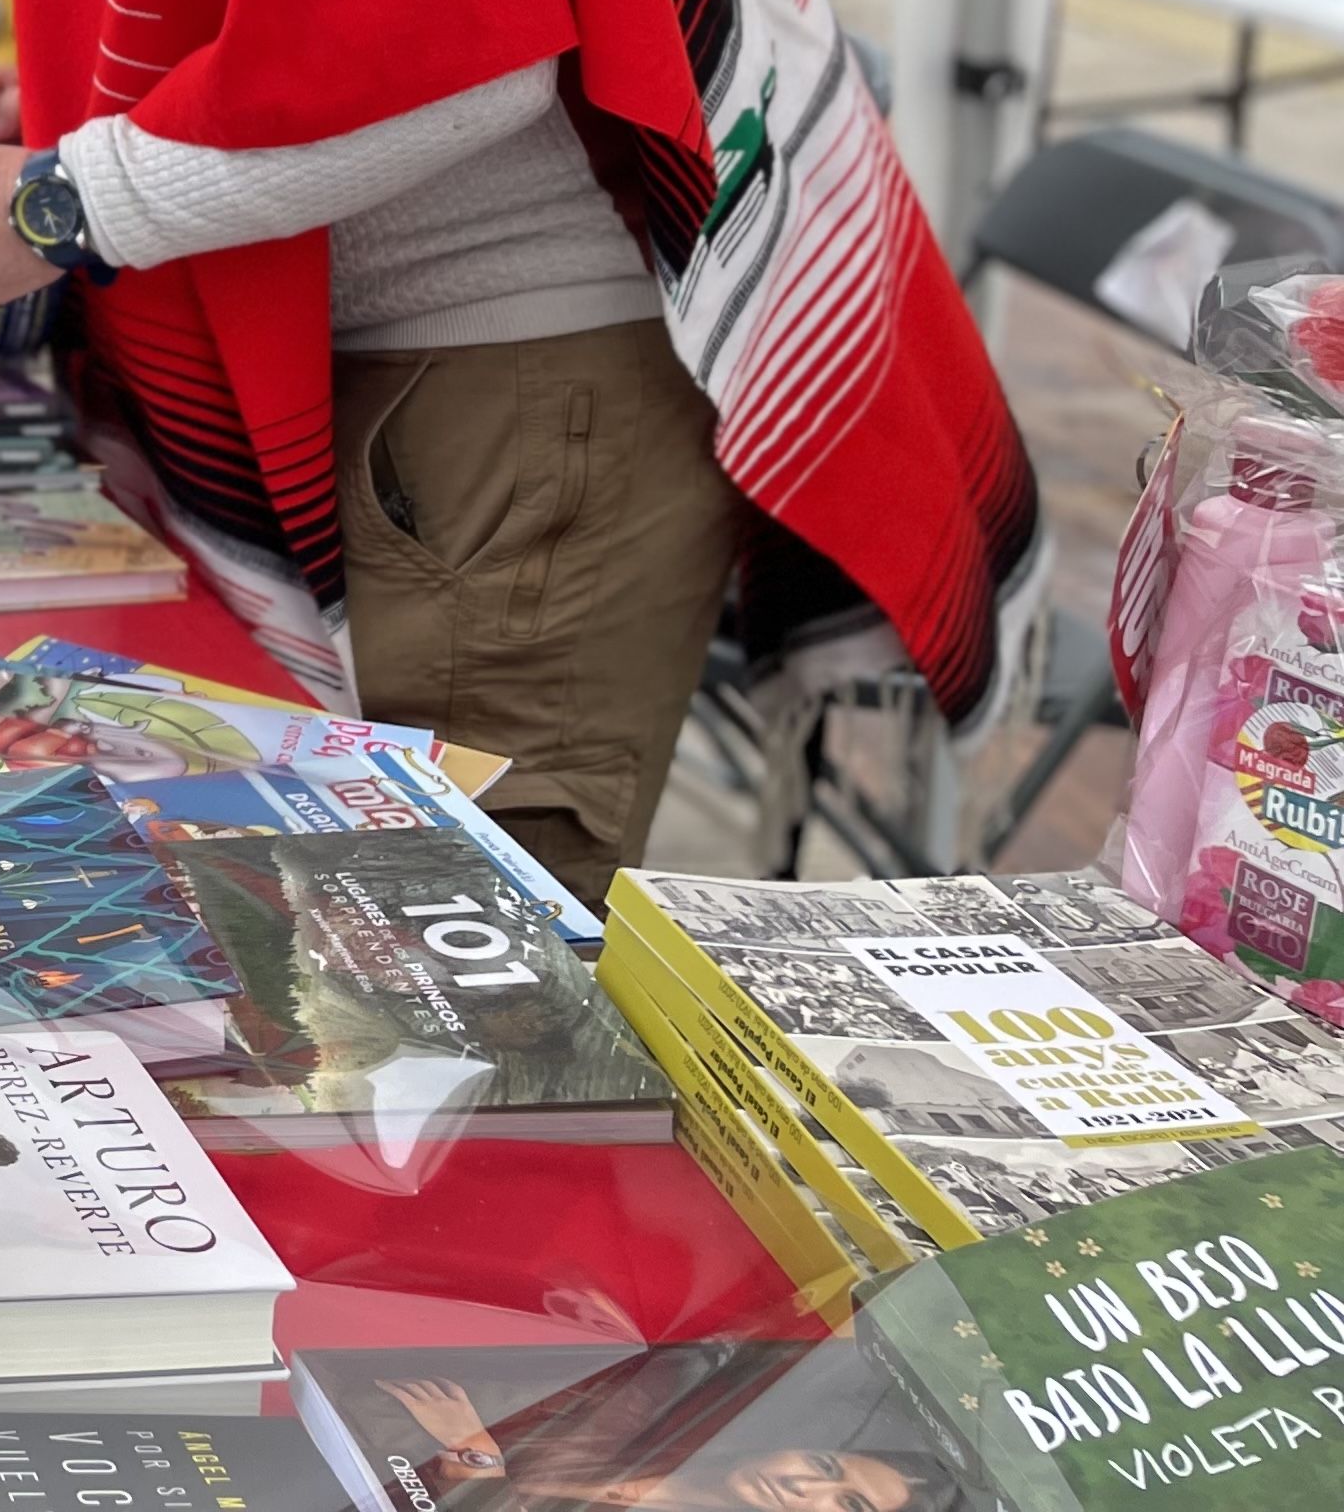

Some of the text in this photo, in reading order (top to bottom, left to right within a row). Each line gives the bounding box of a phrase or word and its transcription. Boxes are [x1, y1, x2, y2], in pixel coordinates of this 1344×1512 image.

[1275, 676, 1344, 721] ROSE
[1238, 749, 1312, 788] M'agrada
[1224, 830, 1338, 895] AntiAgeCream
[1242, 868, 1310, 916] ROSE
[313, 873, 442, 1032] SORPRENDENTES
[335, 872, 466, 1032] LUGARES DE PIRINEOS
[401, 894, 541, 987] 101
[865, 945, 1024, 961] EL CASAL
[1239, 896, 1305, 936] BULGARIA
[883, 960, 1042, 977] POPULAR
[734, 1016, 816, 1107] El Casal Popular
[936, 1006, 1115, 1045] 100
[986, 1040, 1150, 1070] anys
[710, 1050, 780, 1140] El Casal Popular
[1015, 1066, 1179, 1090] cultura
[1035, 1081, 1206, 1112] a Rubí
[25, 1046, 218, 1254] ARTURO
[694, 1091, 750, 1168] Casal Popular
[1076, 1106, 1220, 1129] 1921-2021
[1044, 1235, 1280, 1352] UN BESO
[1003, 1363, 1151, 1453] BAJO
[1142, 1332, 1243, 1409] LA
[48, 1431, 134, 1506] VOC
[126, 1431, 193, 1508] POR SI
[177, 1430, 247, 1508] ÁNGEL M
[1108, 1408, 1322, 1490] VIOLETA
